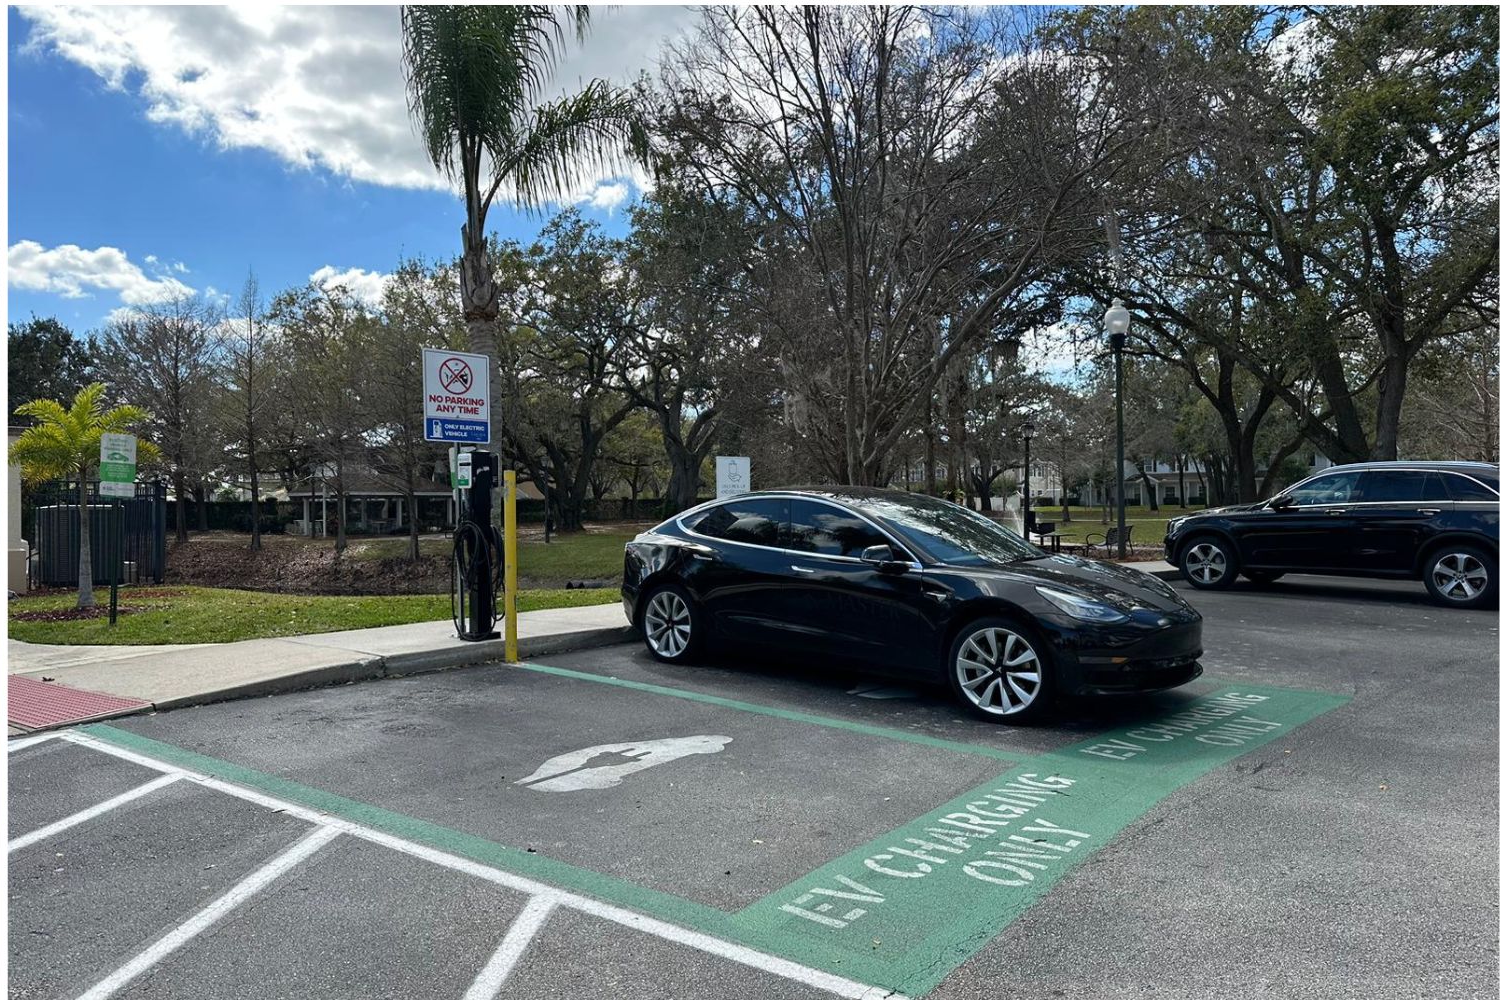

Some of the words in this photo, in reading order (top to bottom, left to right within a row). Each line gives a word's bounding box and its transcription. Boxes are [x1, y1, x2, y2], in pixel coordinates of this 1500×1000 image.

[429, 394, 443, 403] NO
[445, 396, 485, 406] PARKING
[436, 405, 456, 413] ANY
[457, 406, 480, 415] TIME
[1079, 738, 1147, 761] EV
[1126, 692, 1270, 742] CHARGING
[1195, 715, 1282, 747] ONLY
[778, 874, 886, 929] EV
[864, 773, 1077, 879] CHARGING
[963, 818, 1091, 886] ONLY
